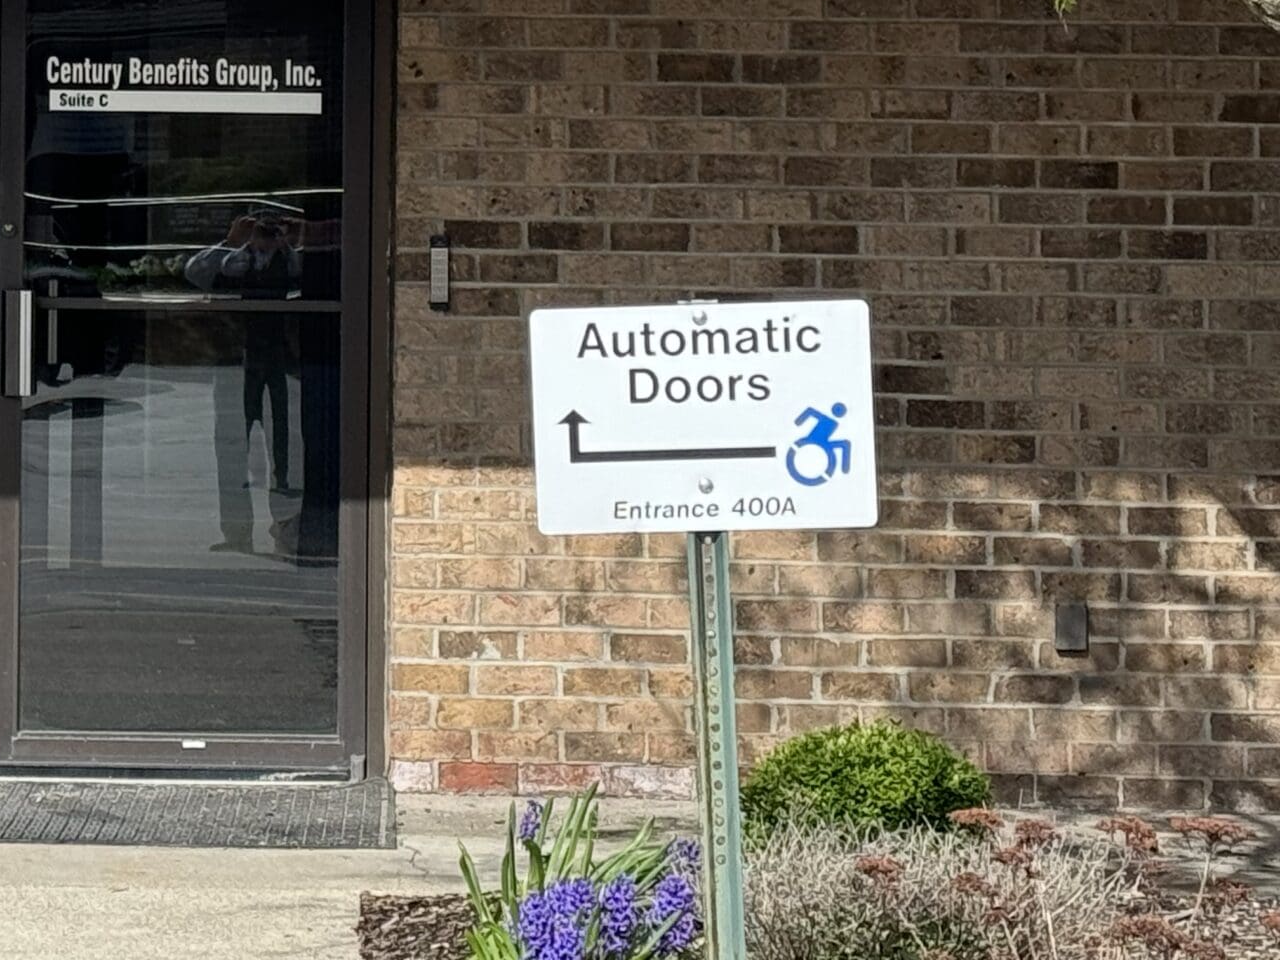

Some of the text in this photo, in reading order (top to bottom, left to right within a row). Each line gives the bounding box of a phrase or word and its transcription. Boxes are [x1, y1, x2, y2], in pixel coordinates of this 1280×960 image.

[46, 55, 322, 91] Century Benefits Group, Inc.
[59, 93, 109, 107] Suite C
[577, 316, 822, 359] Automatic
[629, 367, 770, 404] Doors
[614, 496, 796, 520] Entrance 400A
